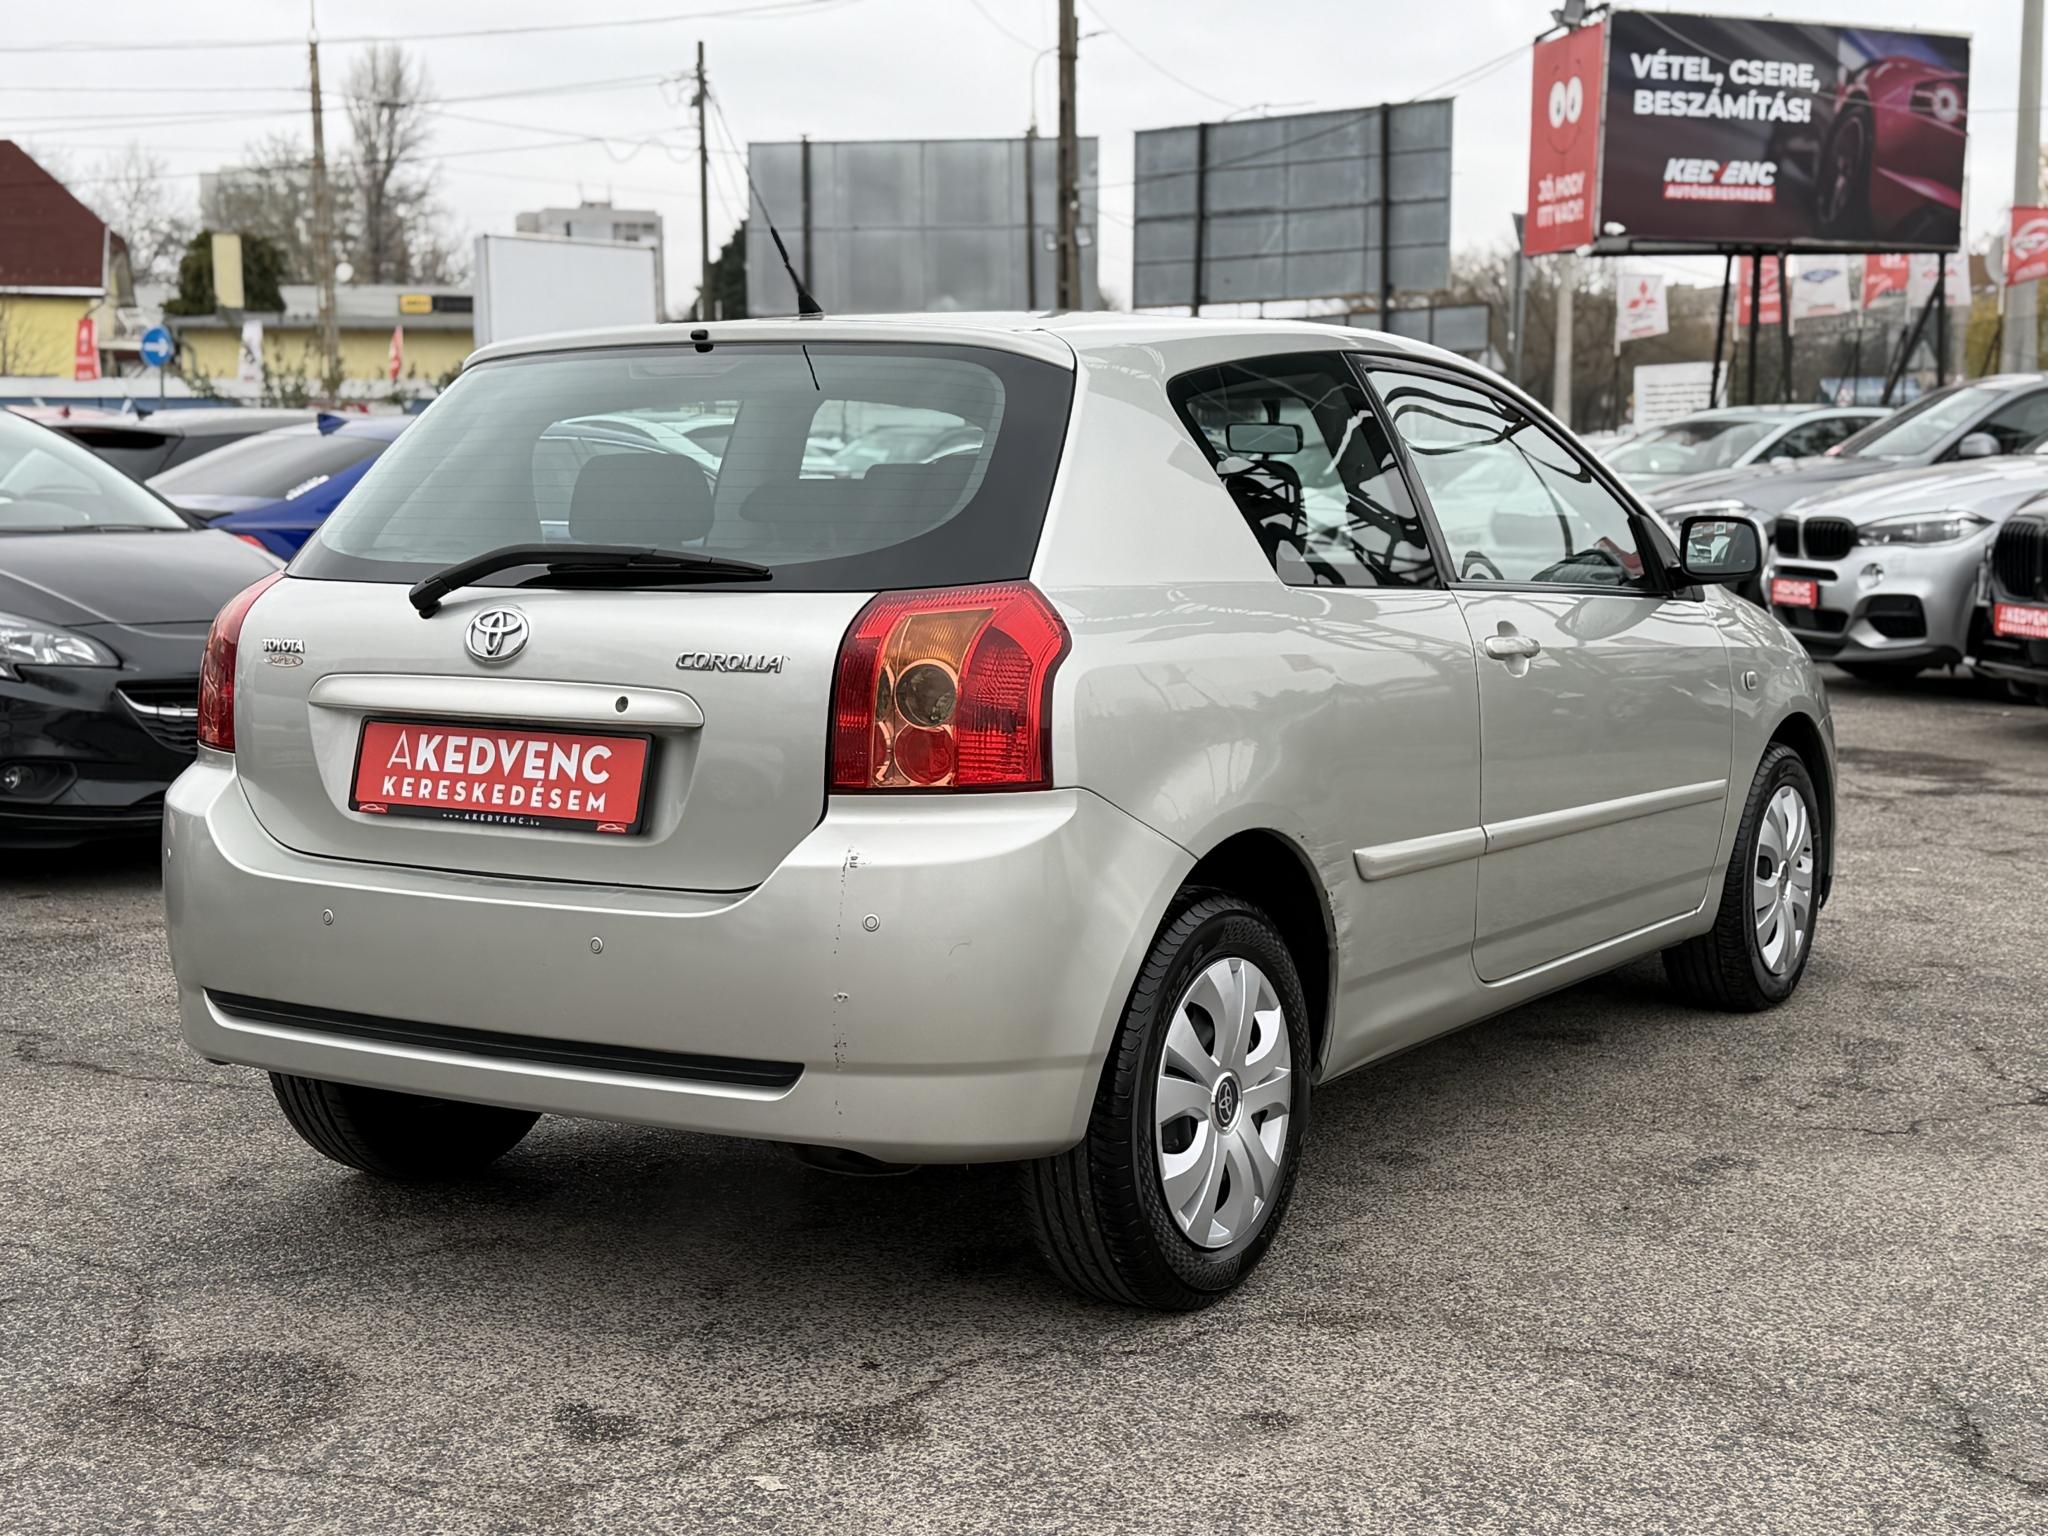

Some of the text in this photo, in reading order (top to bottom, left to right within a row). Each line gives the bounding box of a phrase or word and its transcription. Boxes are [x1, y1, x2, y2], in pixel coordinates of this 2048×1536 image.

[1630, 48, 1821, 94] VÉTEL, CSERE,
[1633, 87, 1812, 124] BESZÁMÍTÁS!
[262, 637, 305, 654] TOYOTA
[676, 651, 784, 674] COROLLA
[381, 775, 607, 814] KERESKEDÉSEM
